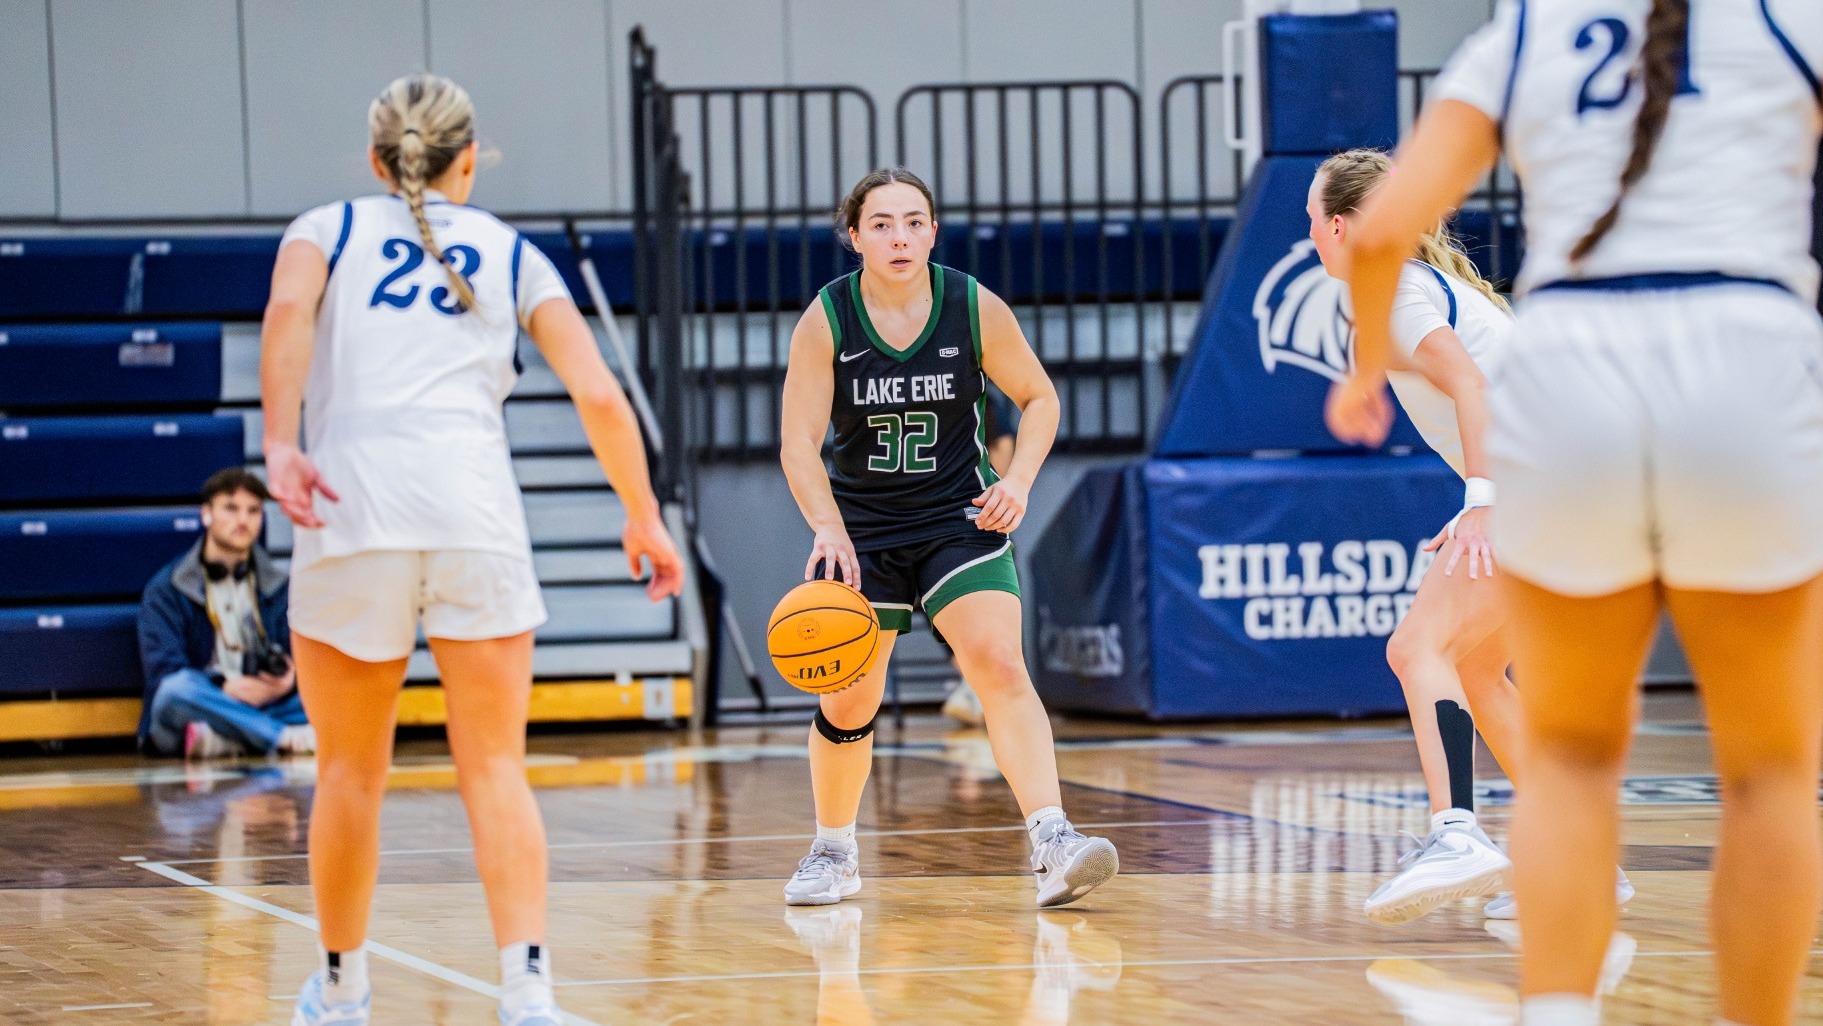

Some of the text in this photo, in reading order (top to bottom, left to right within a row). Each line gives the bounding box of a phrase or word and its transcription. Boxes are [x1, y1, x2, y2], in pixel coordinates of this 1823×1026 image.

[370, 238, 480, 315] 23
[853, 374, 955, 405] LAKE ERIE
[867, 412, 938, 473] 32
[800, 660, 840, 679] EVO
